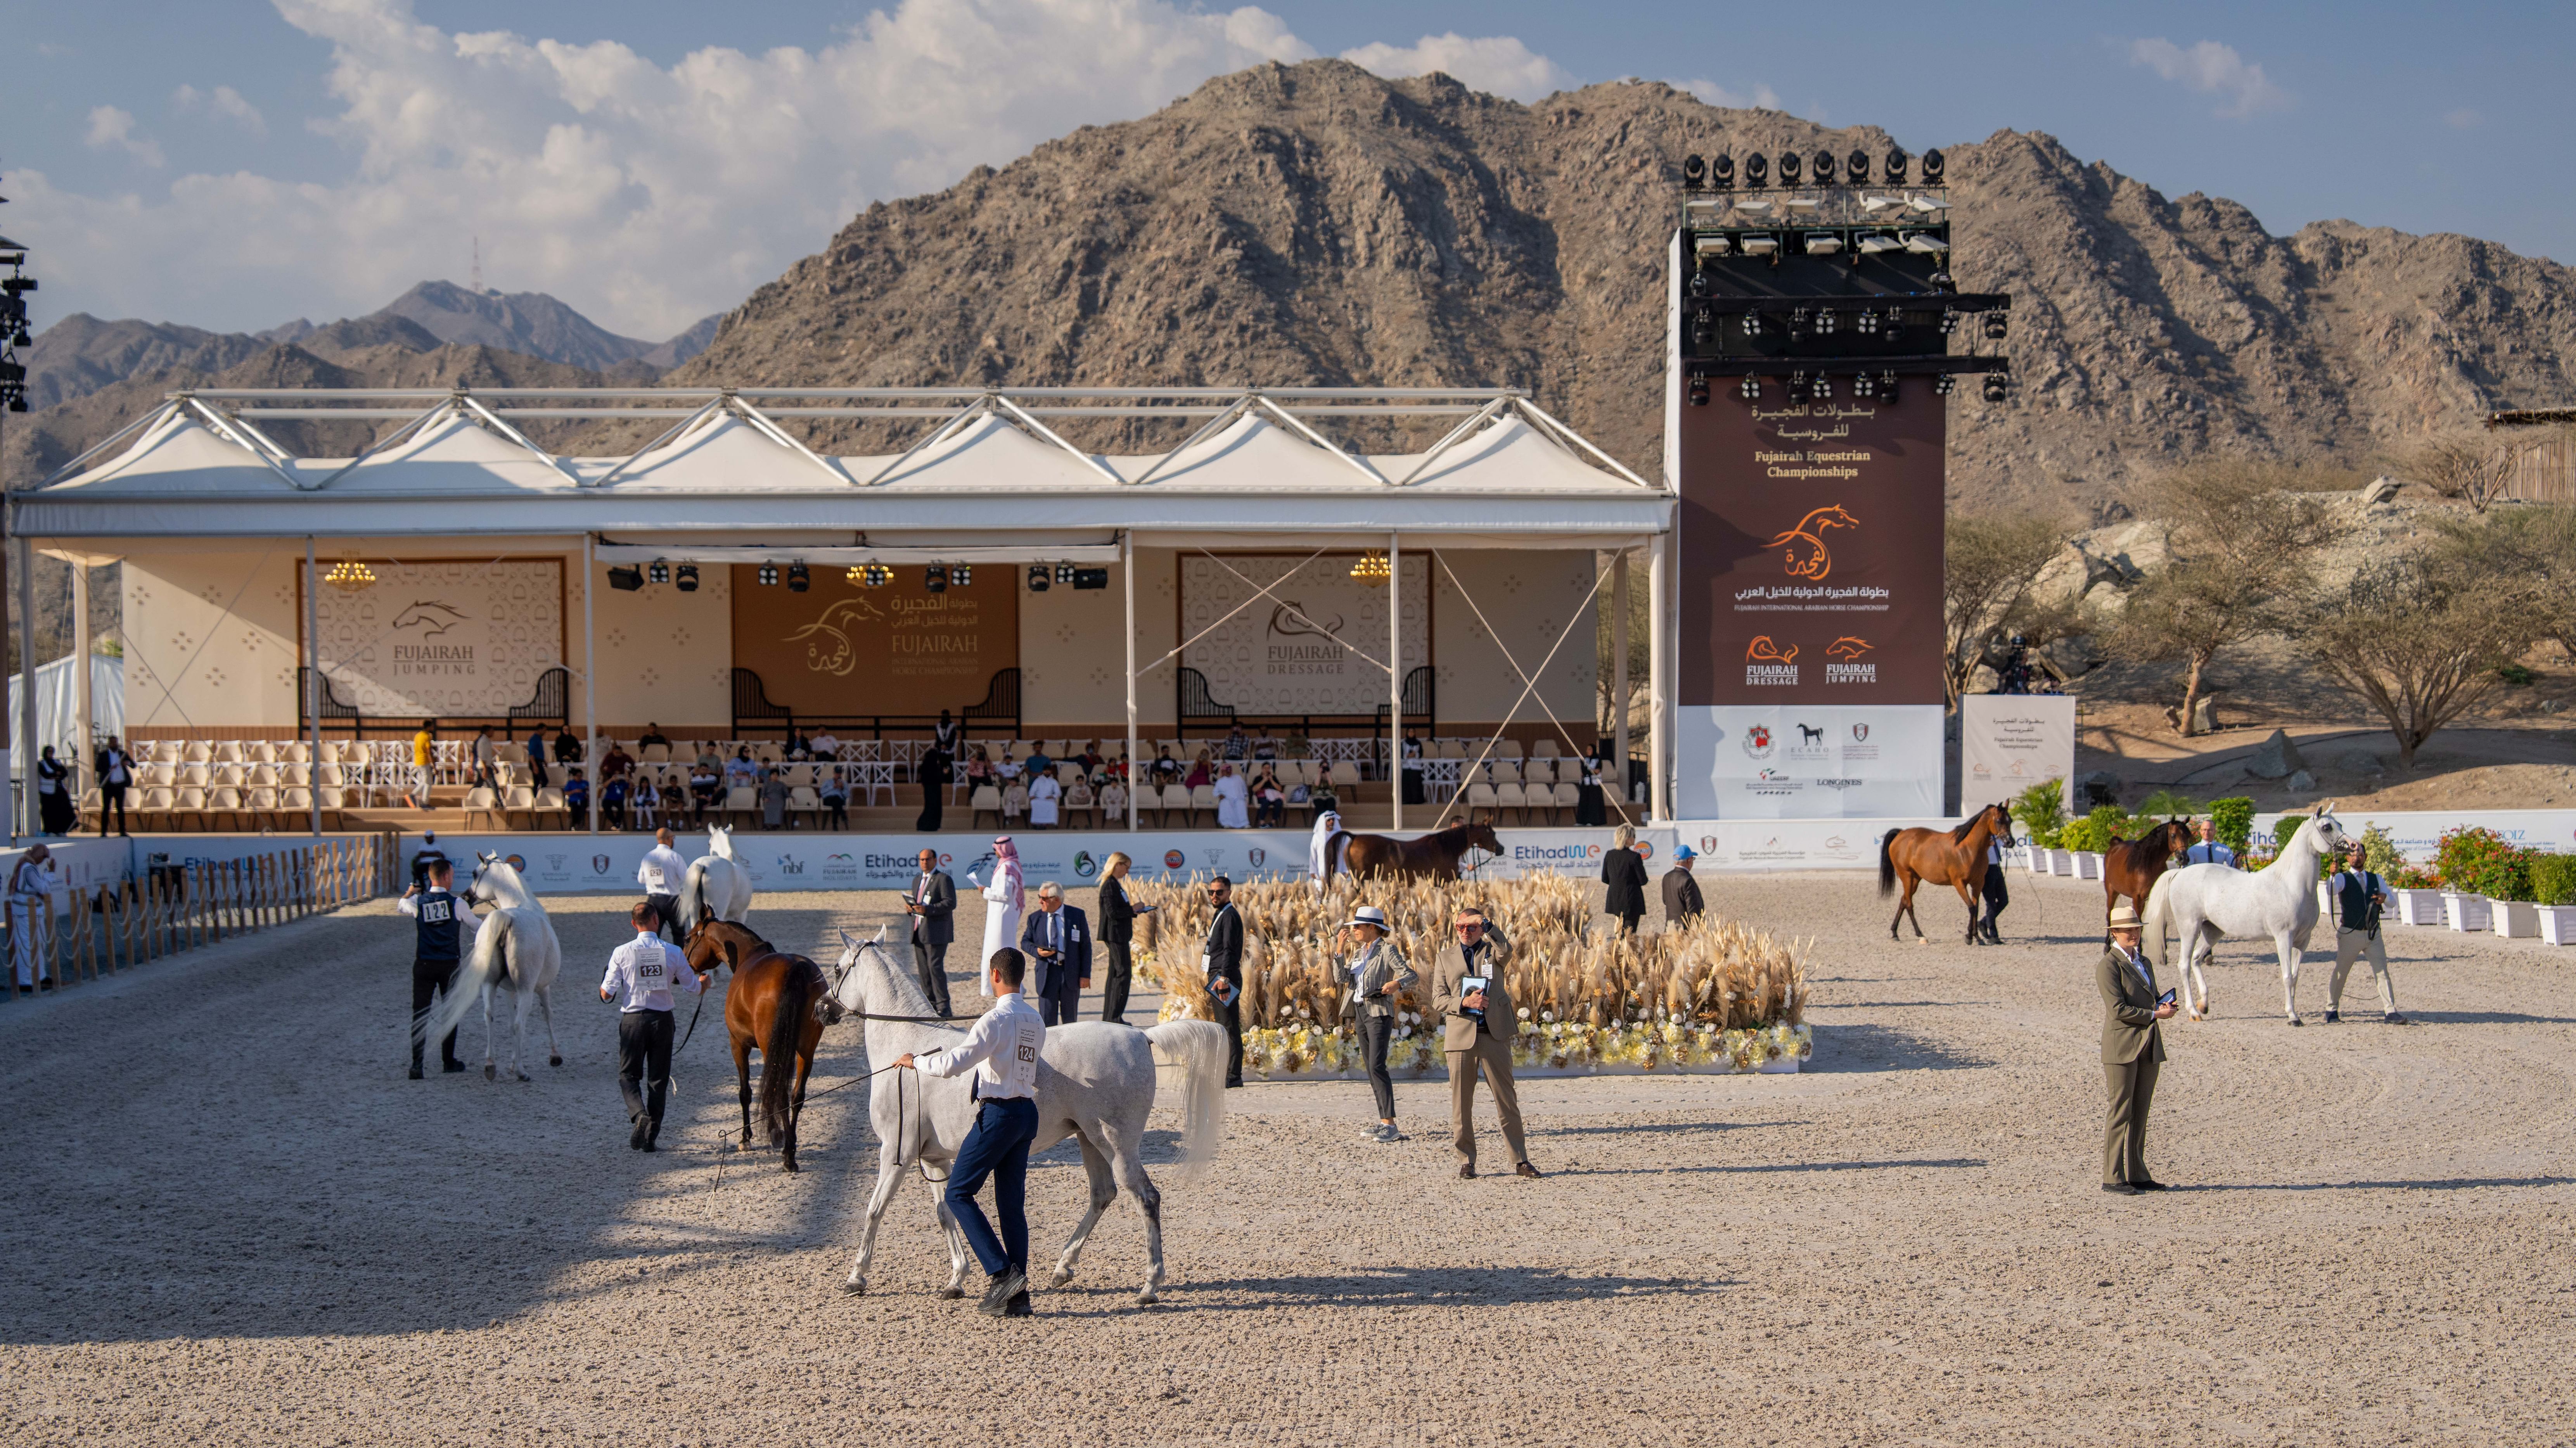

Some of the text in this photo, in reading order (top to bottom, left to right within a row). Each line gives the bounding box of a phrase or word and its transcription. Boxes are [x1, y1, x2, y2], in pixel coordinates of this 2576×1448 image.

[1751, 403, 1809, 422] الفجيرة
[1777, 423, 1849, 441] للفروسية
[1755, 450, 1871, 465] Fujairah Equestrian
[1767, 466, 1858, 480] Championships
[1735, 586, 1889, 600] بطولة الفجيرة الدولية للخيل العربي
[892, 635, 977, 655] FUJAIRAH
[394, 645, 473, 661] FUJAIRAH
[1268, 646, 1343, 661] FUJAIRAH
[394, 664, 475, 675] JUMPING
[1267, 664, 1344, 674] DRESSAGE
[1747, 665, 1798, 676] FUJAIRAH
[1826, 664, 1875, 675] FUJAIRAH
[1746, 677, 1799, 685] DRESSAGE
[1826, 676, 1876, 685] JUMPING
[783, 861, 805, 874] nbf
[426, 903, 448, 919] 122
[642, 966, 661, 976] 123
[1019, 1046, 1033, 1061] 124
